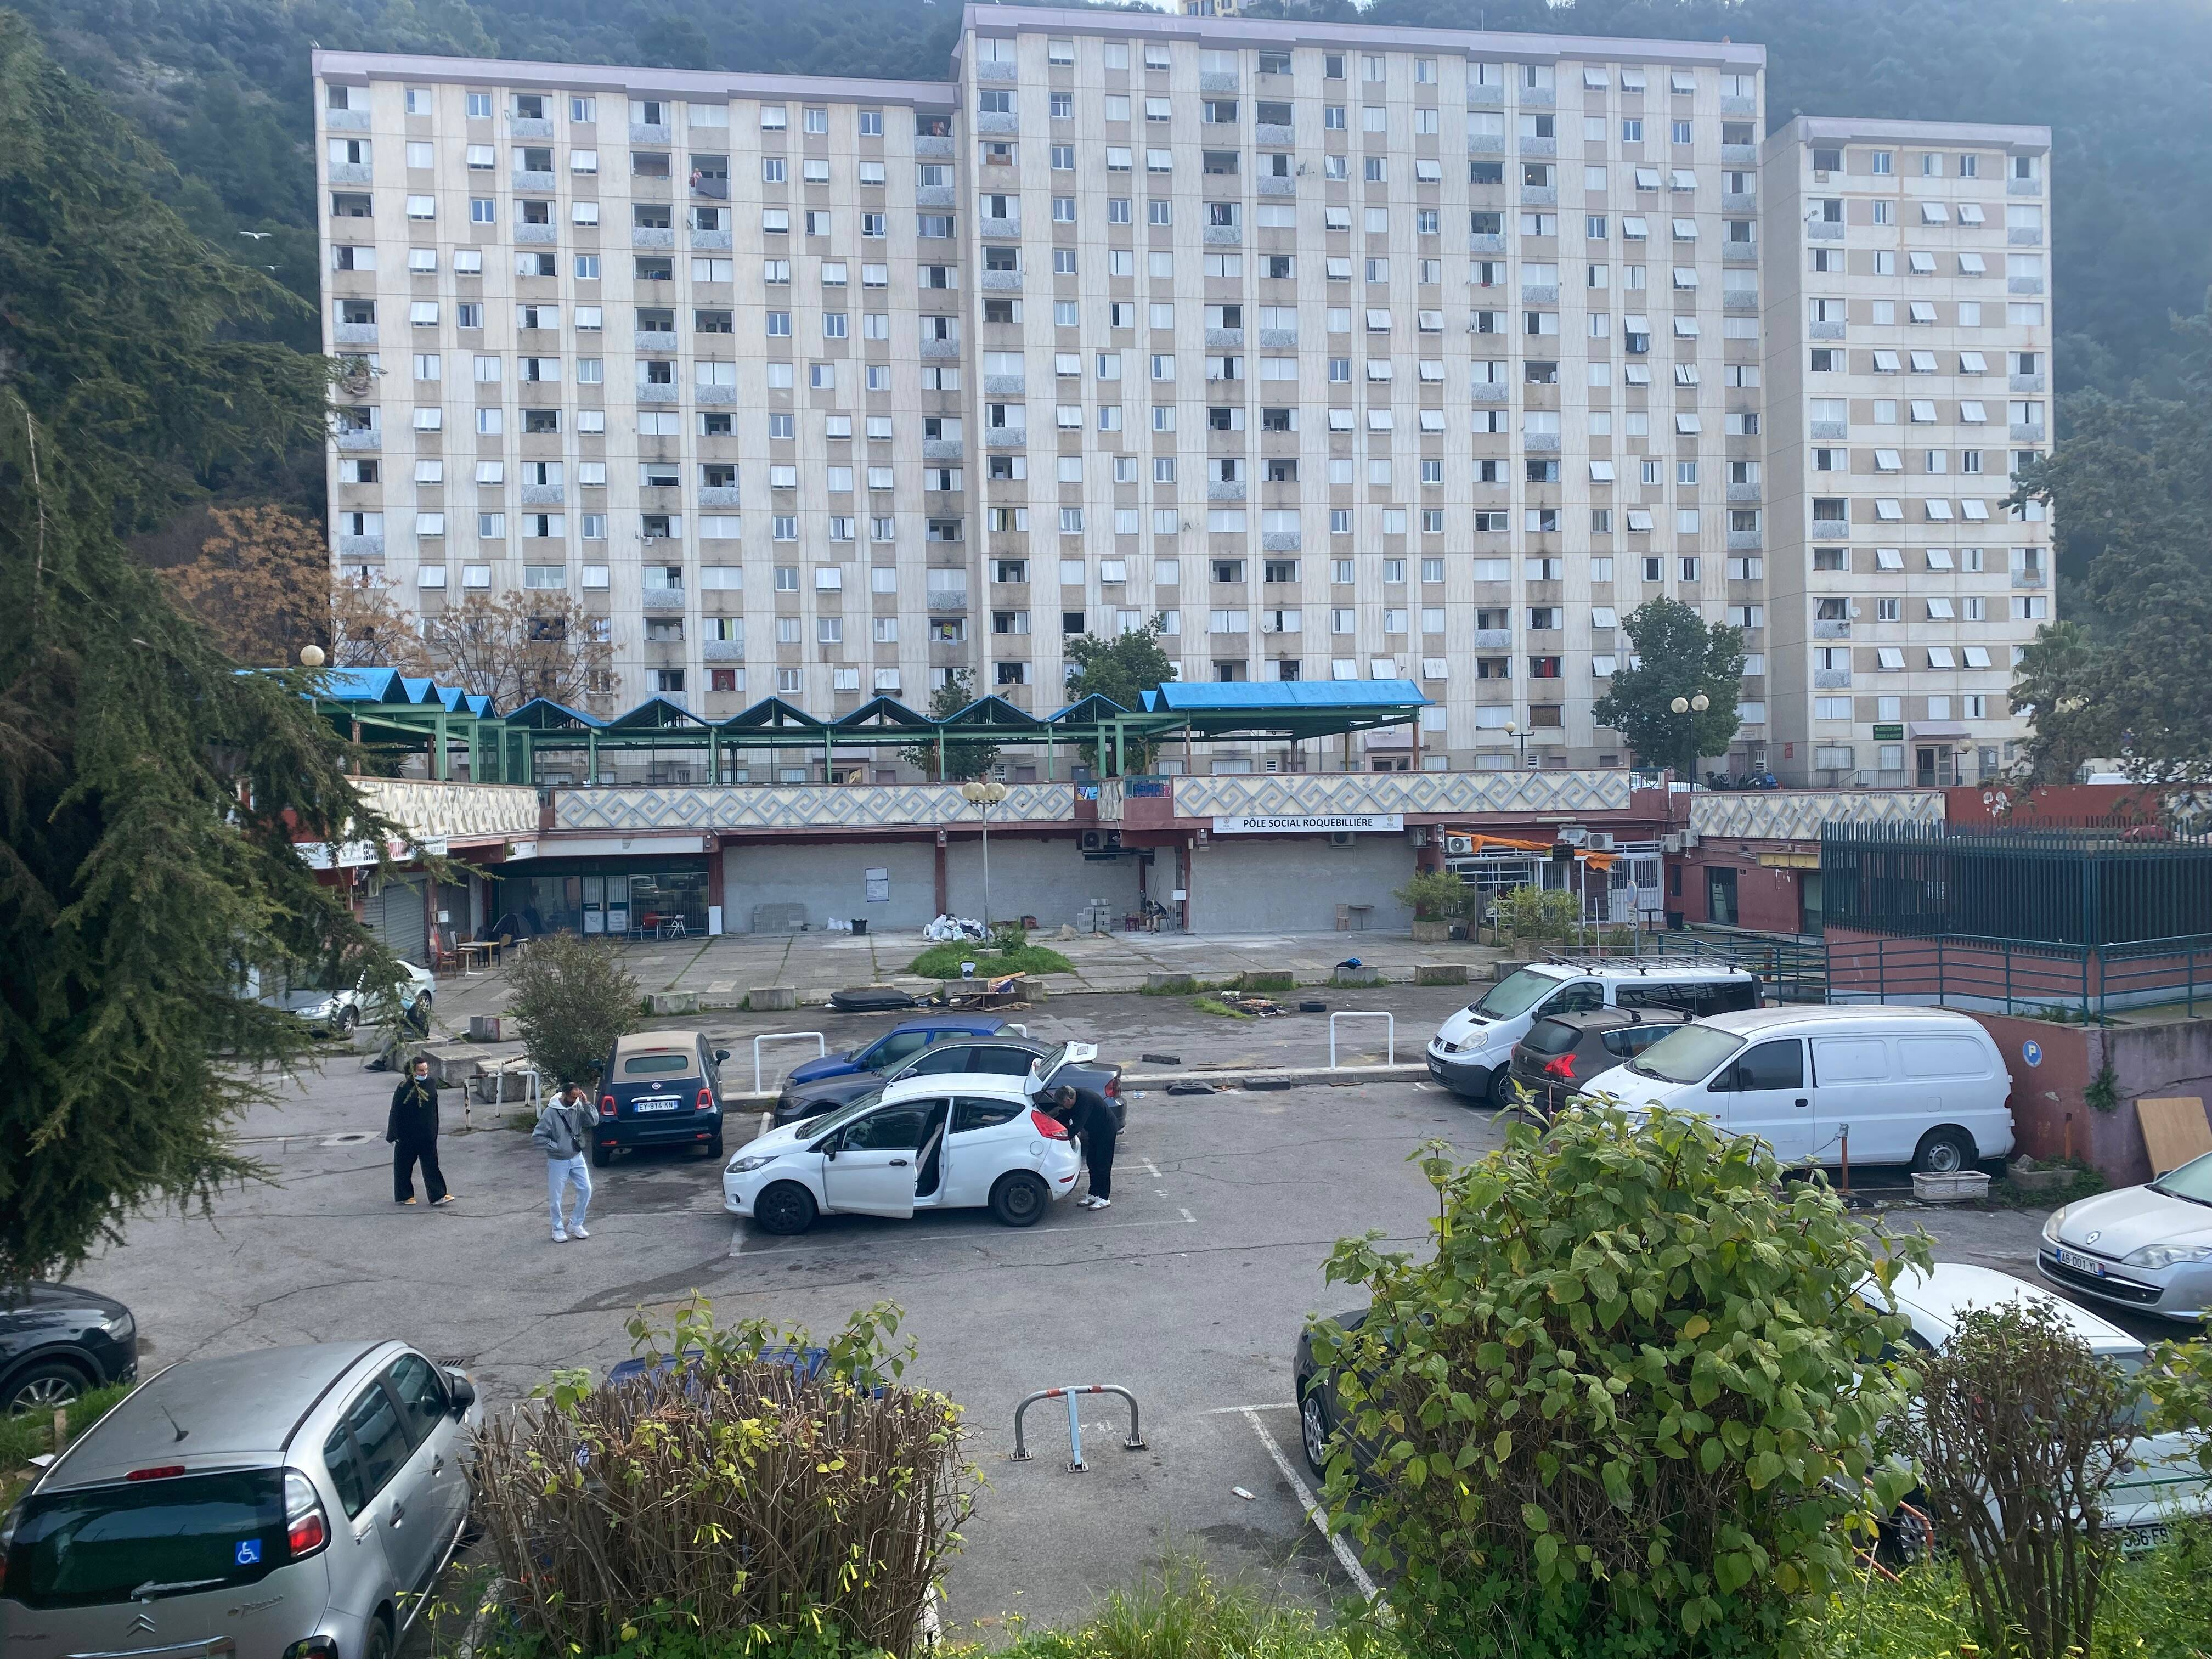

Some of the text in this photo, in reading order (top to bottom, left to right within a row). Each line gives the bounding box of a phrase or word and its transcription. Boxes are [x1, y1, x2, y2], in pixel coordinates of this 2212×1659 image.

[1243, 817, 1266, 827] PÔLE
[1268, 819, 1301, 827] SOCIAL
[1303, 816, 1373, 827] ROQUEBILLIÈRE
[2028, 1044, 2036, 1057] P
[639, 1102, 673, 1110] EY-914-KN
[2062, 1252, 2098, 1274] AB-001-YL
